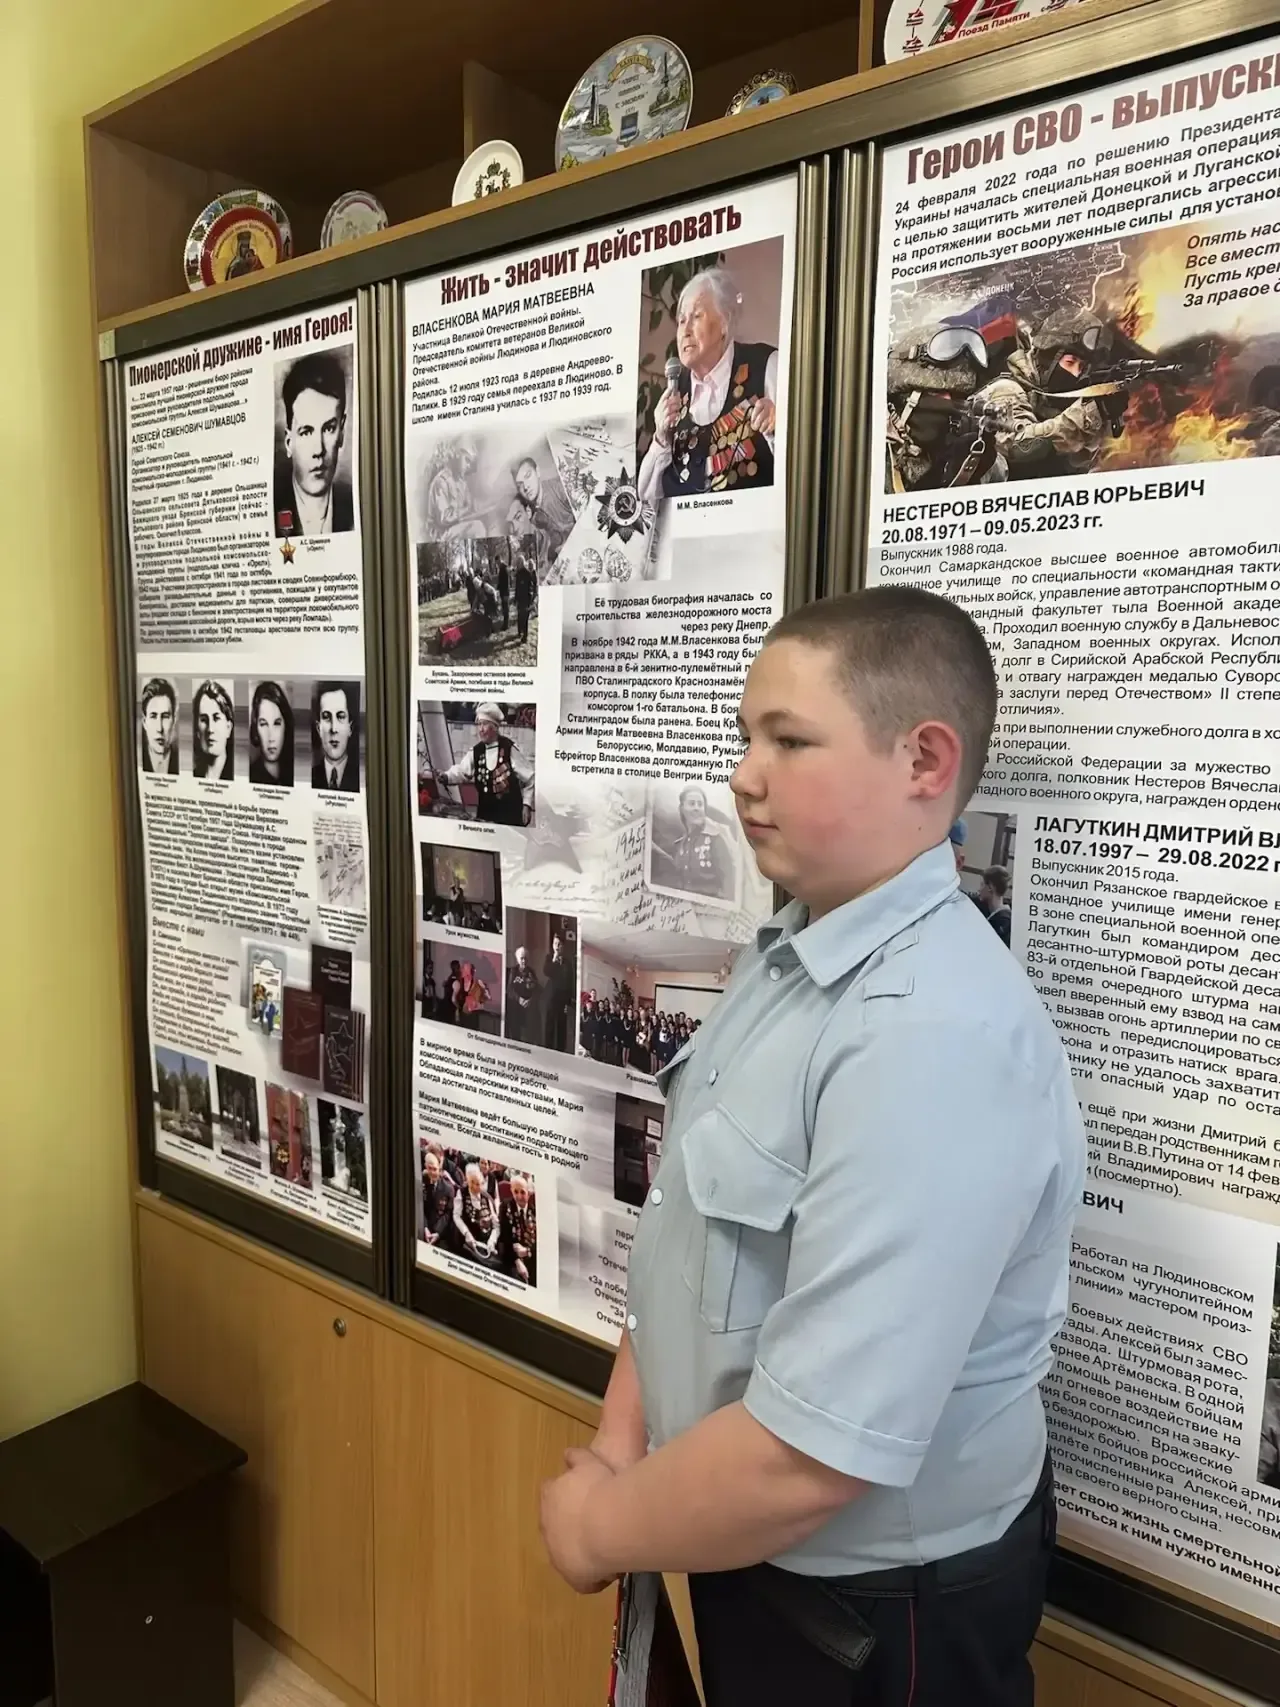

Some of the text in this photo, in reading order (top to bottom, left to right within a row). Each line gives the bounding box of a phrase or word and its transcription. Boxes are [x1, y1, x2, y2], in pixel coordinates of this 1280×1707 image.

[958, 11, 1030, 38] Поезд Памяти
[907, 130, 1004, 184] Герои
[1013, 103, 1082, 155] СВО
[1111, 53, 1280, 129] выпуск
[895, 200, 909, 214] 24
[917, 185, 975, 210] февраля
[985, 172, 1016, 191] 2022
[1025, 164, 1056, 180] года
[1067, 157, 1085, 170] по
[1095, 136, 1169, 166] решению
[895, 209, 950, 230] Украины
[954, 193, 1017, 216] началась
[1022, 166, 1119, 198] специальная
[1125, 149, 1191, 174] военная
[892, 252, 906, 263] на
[911, 232, 991, 260] протяжении
[997, 219, 1050, 239] восьми
[1056, 211, 1082, 226] лет
[1087, 186, 1201, 219] подвергались
[893, 238, 900, 247] с
[904, 226, 947, 245] целью
[952, 210, 1018, 233] защитить
[1023, 190, 1087, 216] жителей
[1091, 170, 1171, 202] Донецкой
[1177, 169, 1187, 180] и
[441, 273, 489, 305] Жить
[505, 247, 579, 288] значит
[583, 204, 741, 273] действовать
[891, 261, 936, 279] Россия
[939, 243, 1018, 268] использует
[1021, 220, 1126, 251] вооруженные
[1129, 210, 1172, 228] силы
[1179, 201, 1212, 220] для
[1187, 230, 1246, 249] Опять
[412, 282, 594, 337] ВЛАСЕНКОВА МАРИЯ МАТВЕЕВНА
[1183, 283, 1270, 307] За правое
[129, 348, 200, 387] Пионерской
[202, 335, 262, 371] дружине
[272, 324, 302, 350] имя
[305, 305, 352, 342] Героя!
[131, 412, 246, 444] АЛЕКСЕЙ СЕМЕНОВИЧ ШУМАВЦОВ
[883, 479, 1204, 523] НЕСТЕРОВ ВЯЧЕСЛАВ ЮРЬЕВИЧ
[881, 522, 965, 544] 20.08.1971
[984, 513, 1079, 536] 09.05.2023
[1083, 515, 1102, 528] гг.
[880, 541, 1280, 576] Окончил Самаркандское высшее военное автомобил
[881, 543, 1006, 562] Выпускник 1988 года.
[575, 606, 771, 624] строительства железнодорожного моста
[594, 592, 772, 609] Её трудовая биография началась со
[680, 619, 770, 634] через реку Днепр.
[575, 675, 672, 687] ПВО Сталинградского
[554, 749, 722, 770] Ефрейтор Власенкова долгожданную
[996, 752, 1270, 775] Российской Федерации за мужество
[1034, 816, 1253, 846] ЛАГУТКИН ДМИТРИЙ
[1031, 857, 1178, 882] Выпускник 2015 года.
[1034, 837, 1133, 859] 18.07.1997
[1157, 847, 1269, 871] 29.08.2022
[1030, 873, 1268, 908] Окончил Рязанское гвардейское
[1087, 1103, 1266, 1148] ещё при жизни Дмитрий
[1071, 1242, 1253, 1302] Работал на Людиновском
[1071, 1302, 1248, 1365] боевых действиях СВО
[1093, 1447, 1173, 1484] противника
[1151, 1436, 1232, 1474] Вражеские
[1079, 1491, 1169, 1533] свою жизнь
[1120, 1522, 1216, 1568] к ним нужно
